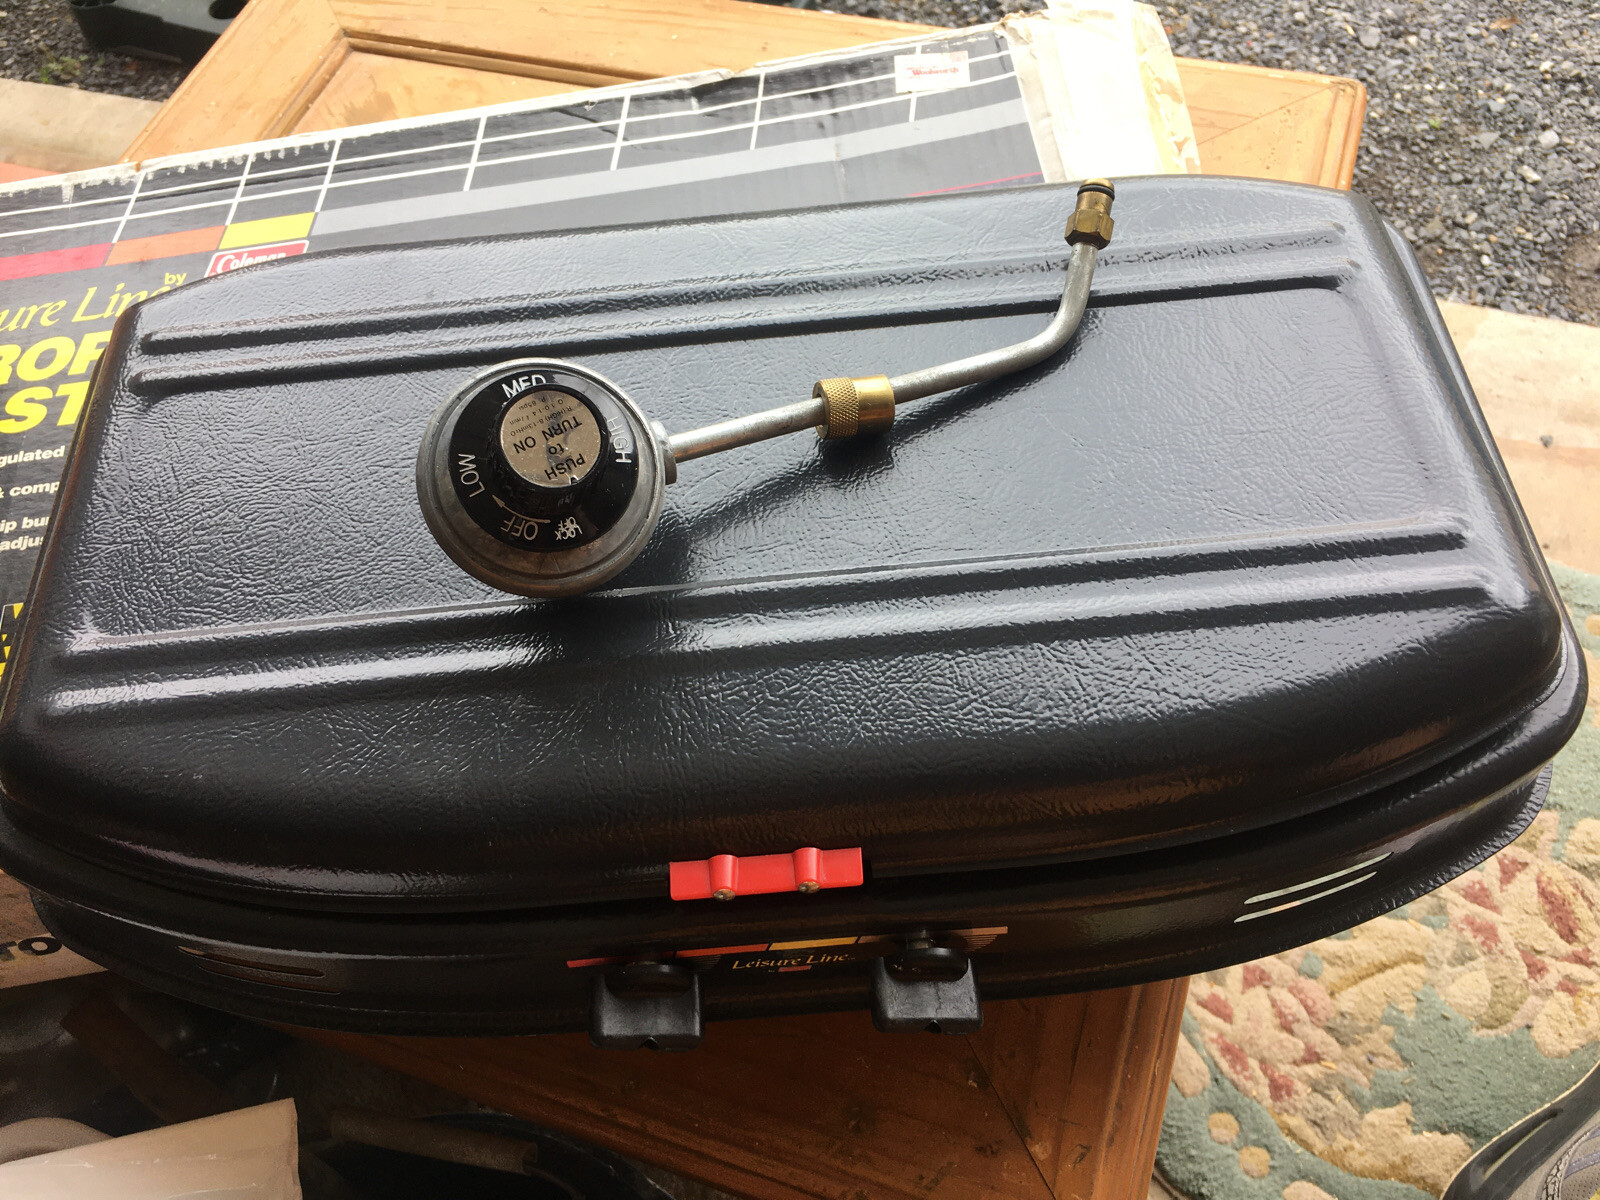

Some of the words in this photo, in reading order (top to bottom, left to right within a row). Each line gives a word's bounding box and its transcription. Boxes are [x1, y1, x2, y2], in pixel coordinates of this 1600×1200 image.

[164, 272, 187, 286] by
[72, 282, 171, 323] Lin
[501, 374, 547, 399] MED
[541, 416, 583, 441] TURN
[607, 416, 632, 464] HIGH
[513, 436, 536, 454] ON
[548, 443, 565, 455] to
[457, 453, 486, 498] LOW
[544, 453, 586, 480] PUSH
[500, 515, 539, 541] OFF
[554, 525, 583, 541] LOCK
[732, 957, 802, 970] Leisure
[805, 952, 849, 964] Line
